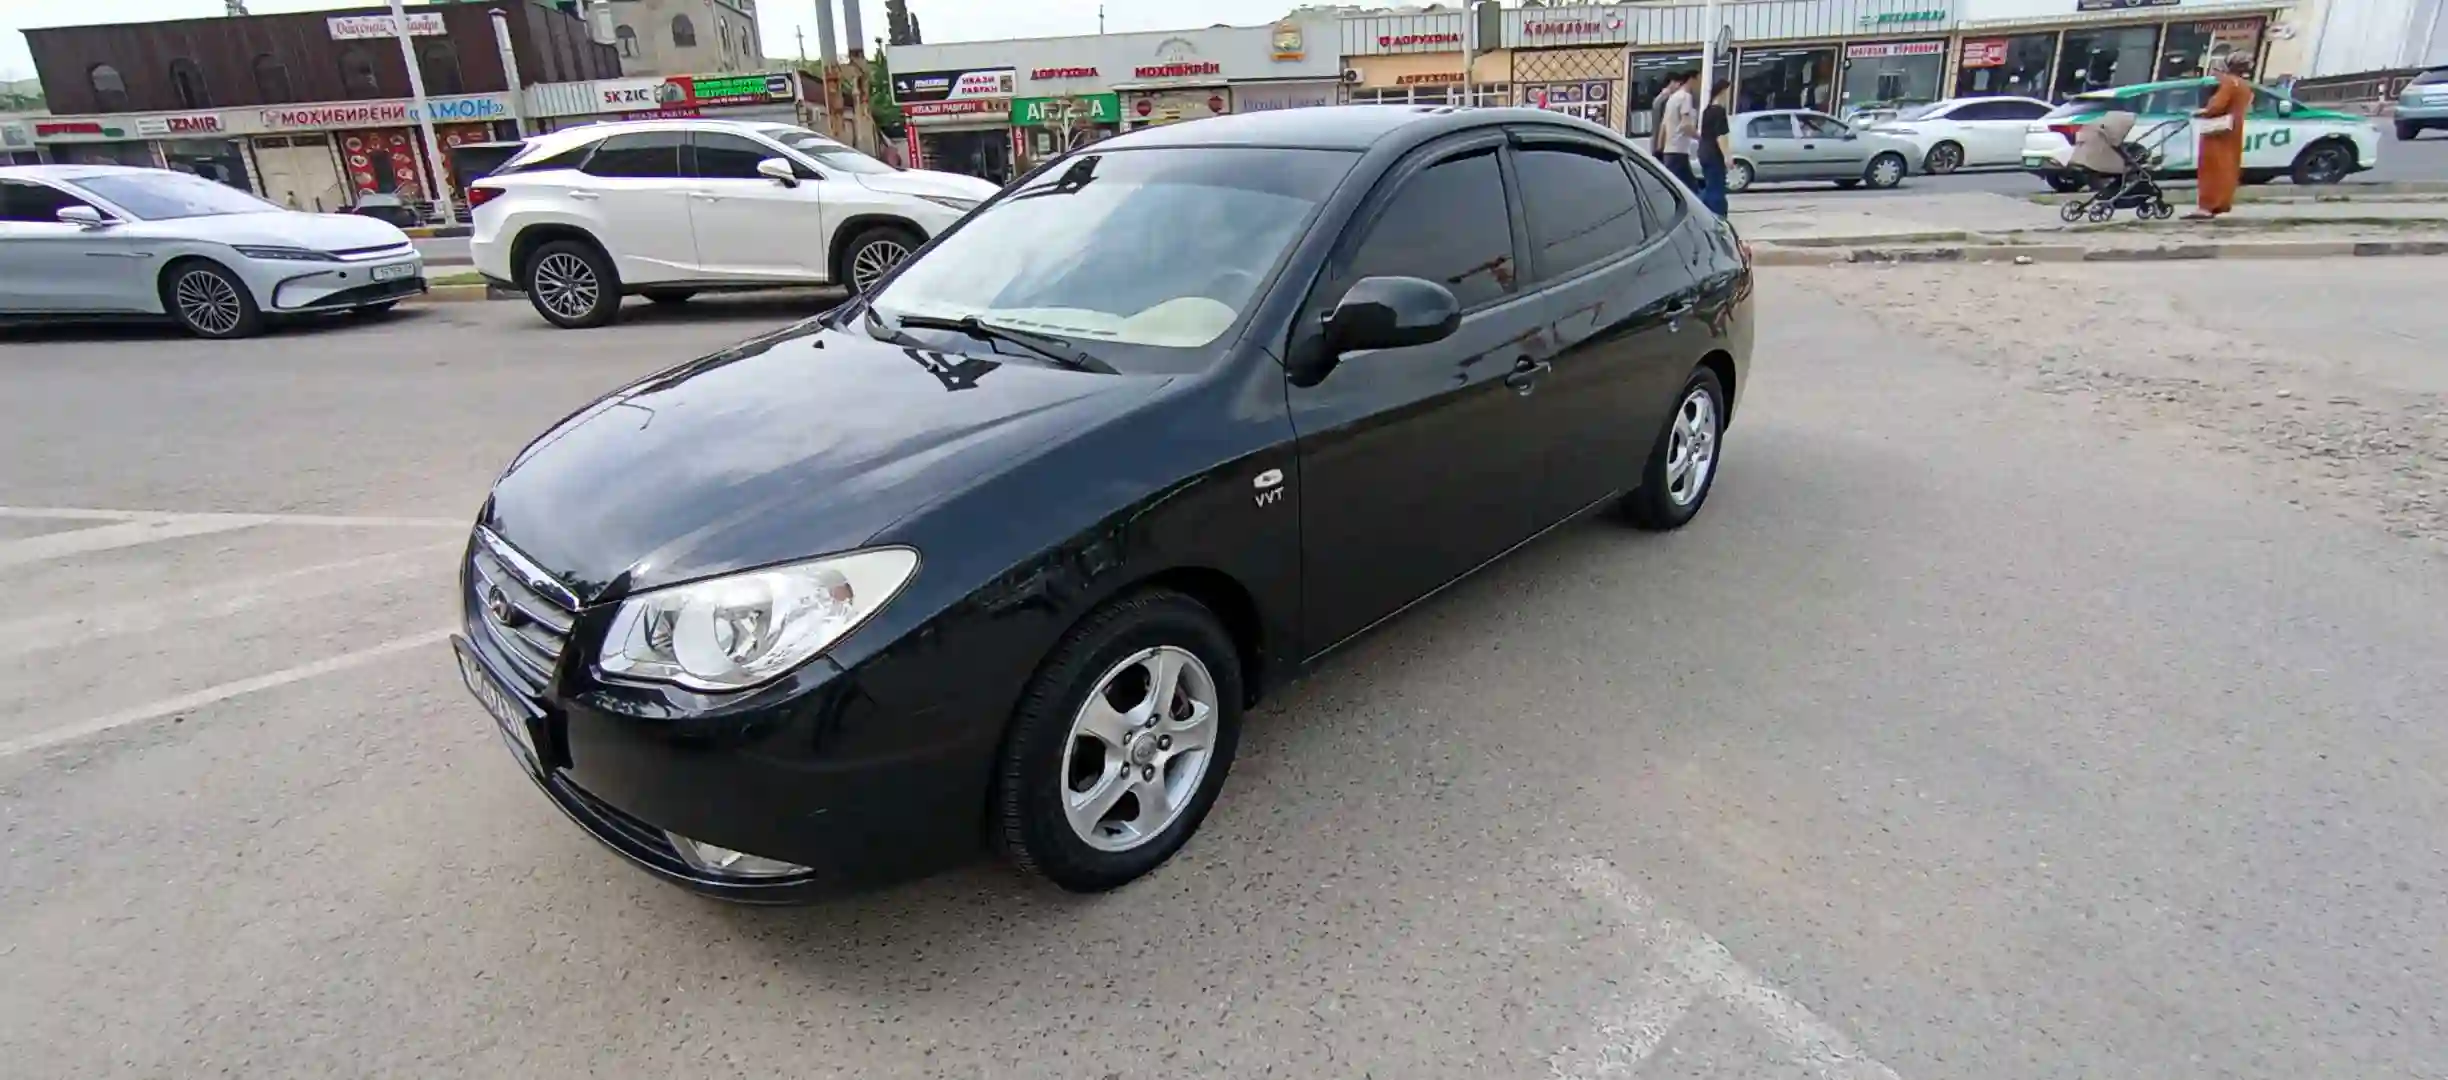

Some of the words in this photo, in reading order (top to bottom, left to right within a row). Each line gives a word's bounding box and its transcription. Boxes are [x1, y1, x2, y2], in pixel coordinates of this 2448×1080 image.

[623, 89, 650, 102] ZIC
[166, 116, 218, 132] IZMIR
[1255, 486, 1285, 508] VVT
